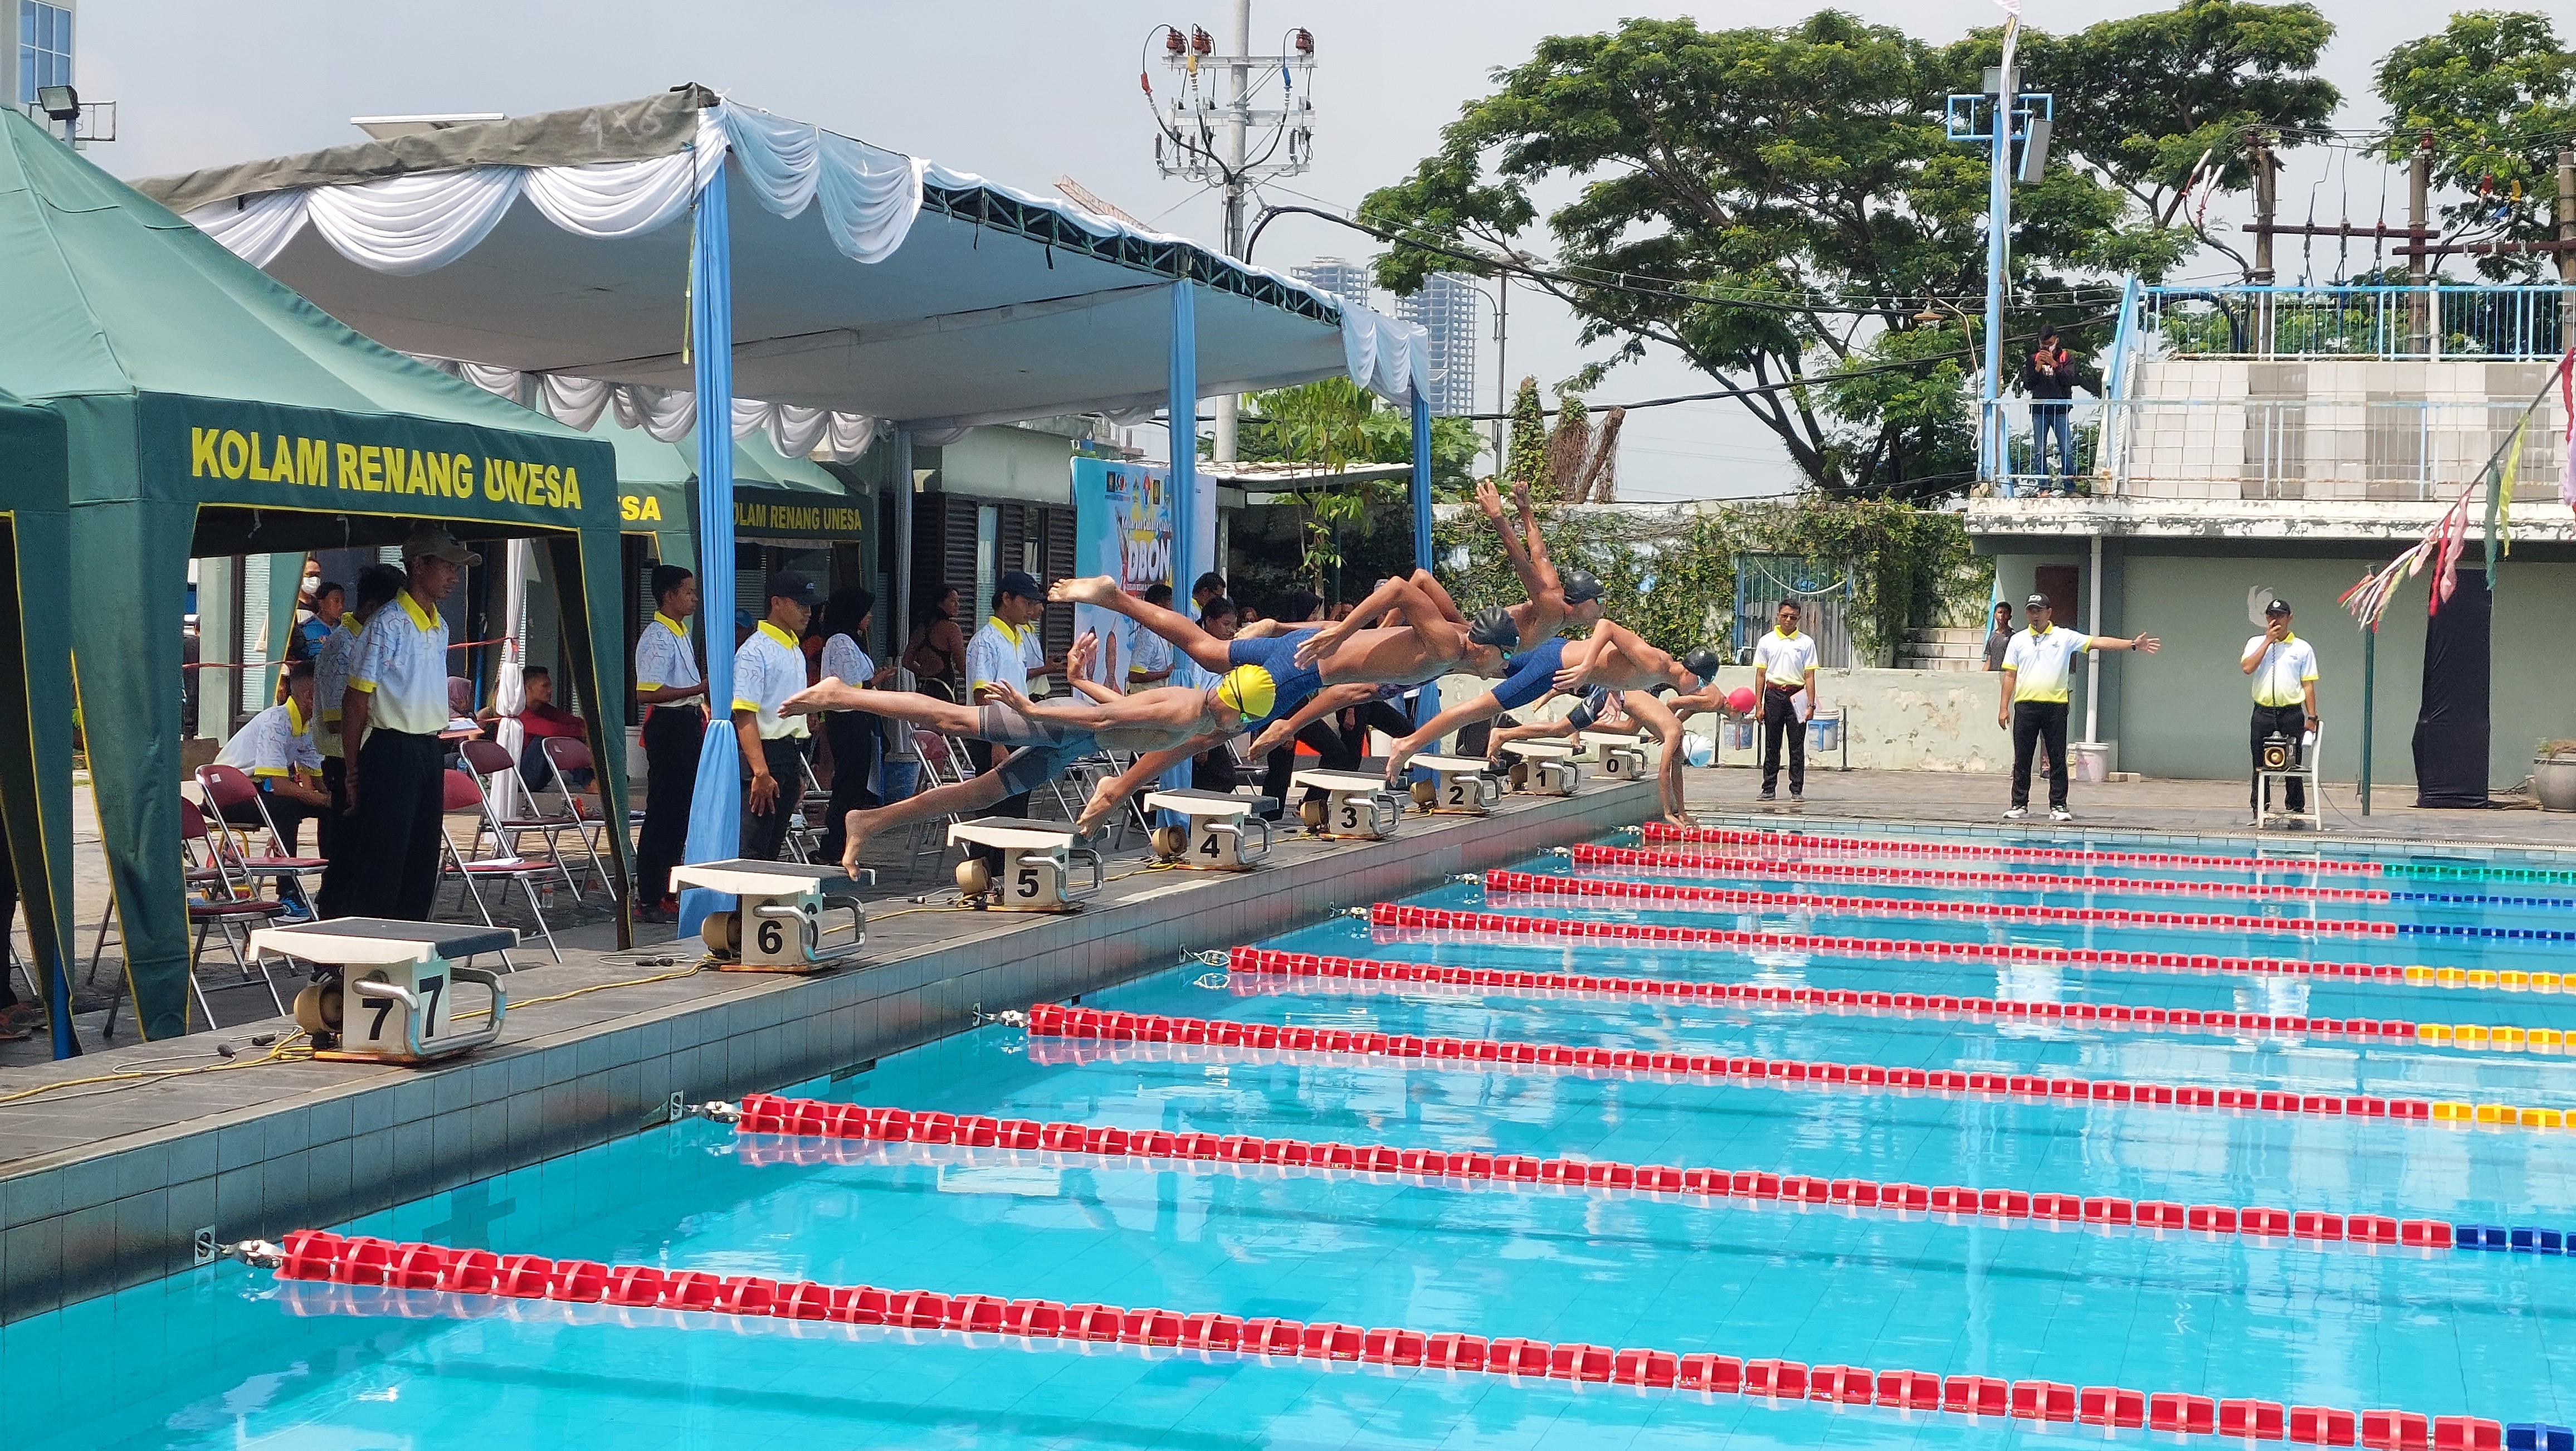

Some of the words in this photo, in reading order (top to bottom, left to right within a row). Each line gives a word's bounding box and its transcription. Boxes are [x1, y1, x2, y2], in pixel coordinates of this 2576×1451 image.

[192, 427, 328, 488] KOLAM
[336, 442, 474, 499] RENANG
[484, 456, 582, 509] UNESA
[618, 495, 661, 521] SA
[733, 501, 765, 528] OLAM
[770, 505, 819, 530] RENANG
[823, 508, 862, 530] UNESA
[1128, 538, 1170, 581] DBON
[1536, 770, 1546, 787] 1
[1607, 758, 1619, 773] 0
[1449, 785, 1464, 805] 2
[1341, 807, 1357, 829] 3
[1200, 834, 1220, 859] 4
[1017, 869, 1039, 898] 5
[758, 919, 783, 954] 6
[362, 997, 393, 1041] 7
[419, 975, 444, 1038] 7
